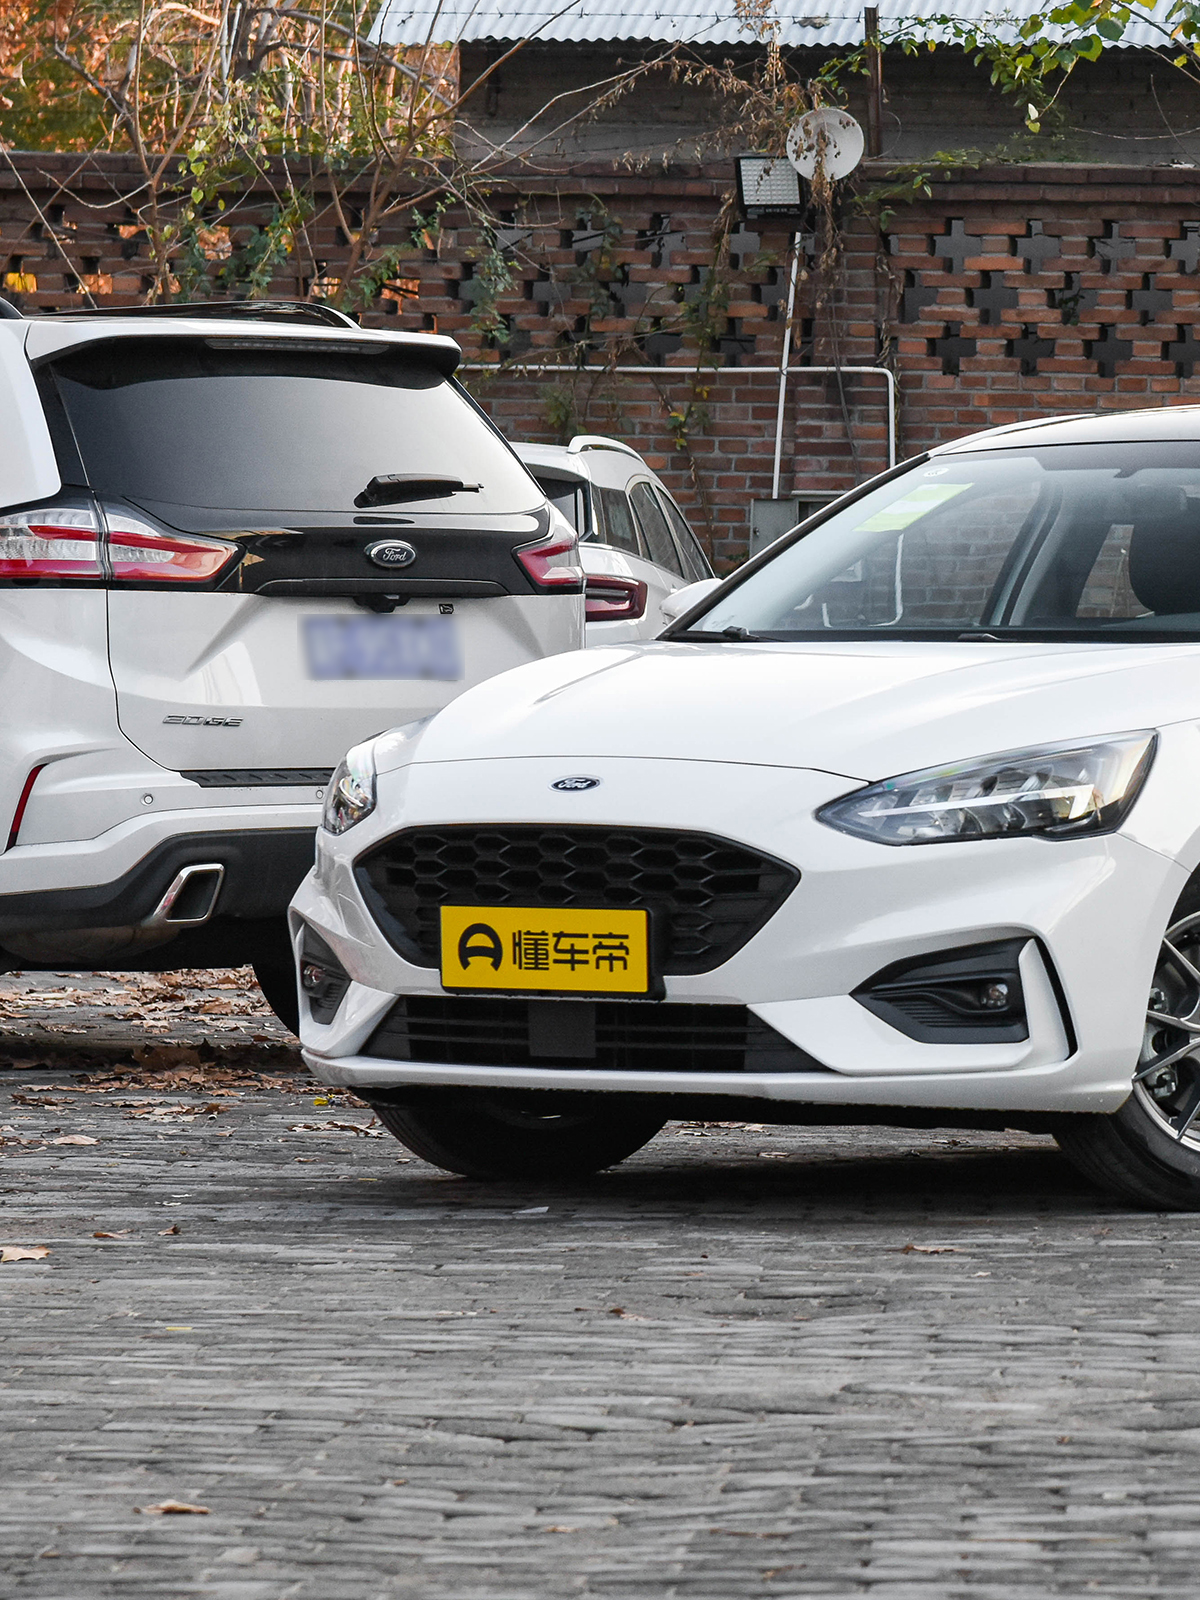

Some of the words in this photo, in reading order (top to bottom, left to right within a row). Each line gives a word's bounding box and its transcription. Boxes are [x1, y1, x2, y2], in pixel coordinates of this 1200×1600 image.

[382, 547, 407, 561] Ford
[162, 714, 243, 727] EDGE
[558, 778, 592, 789] Ford
[512, 930, 630, 973] 懂车帝
